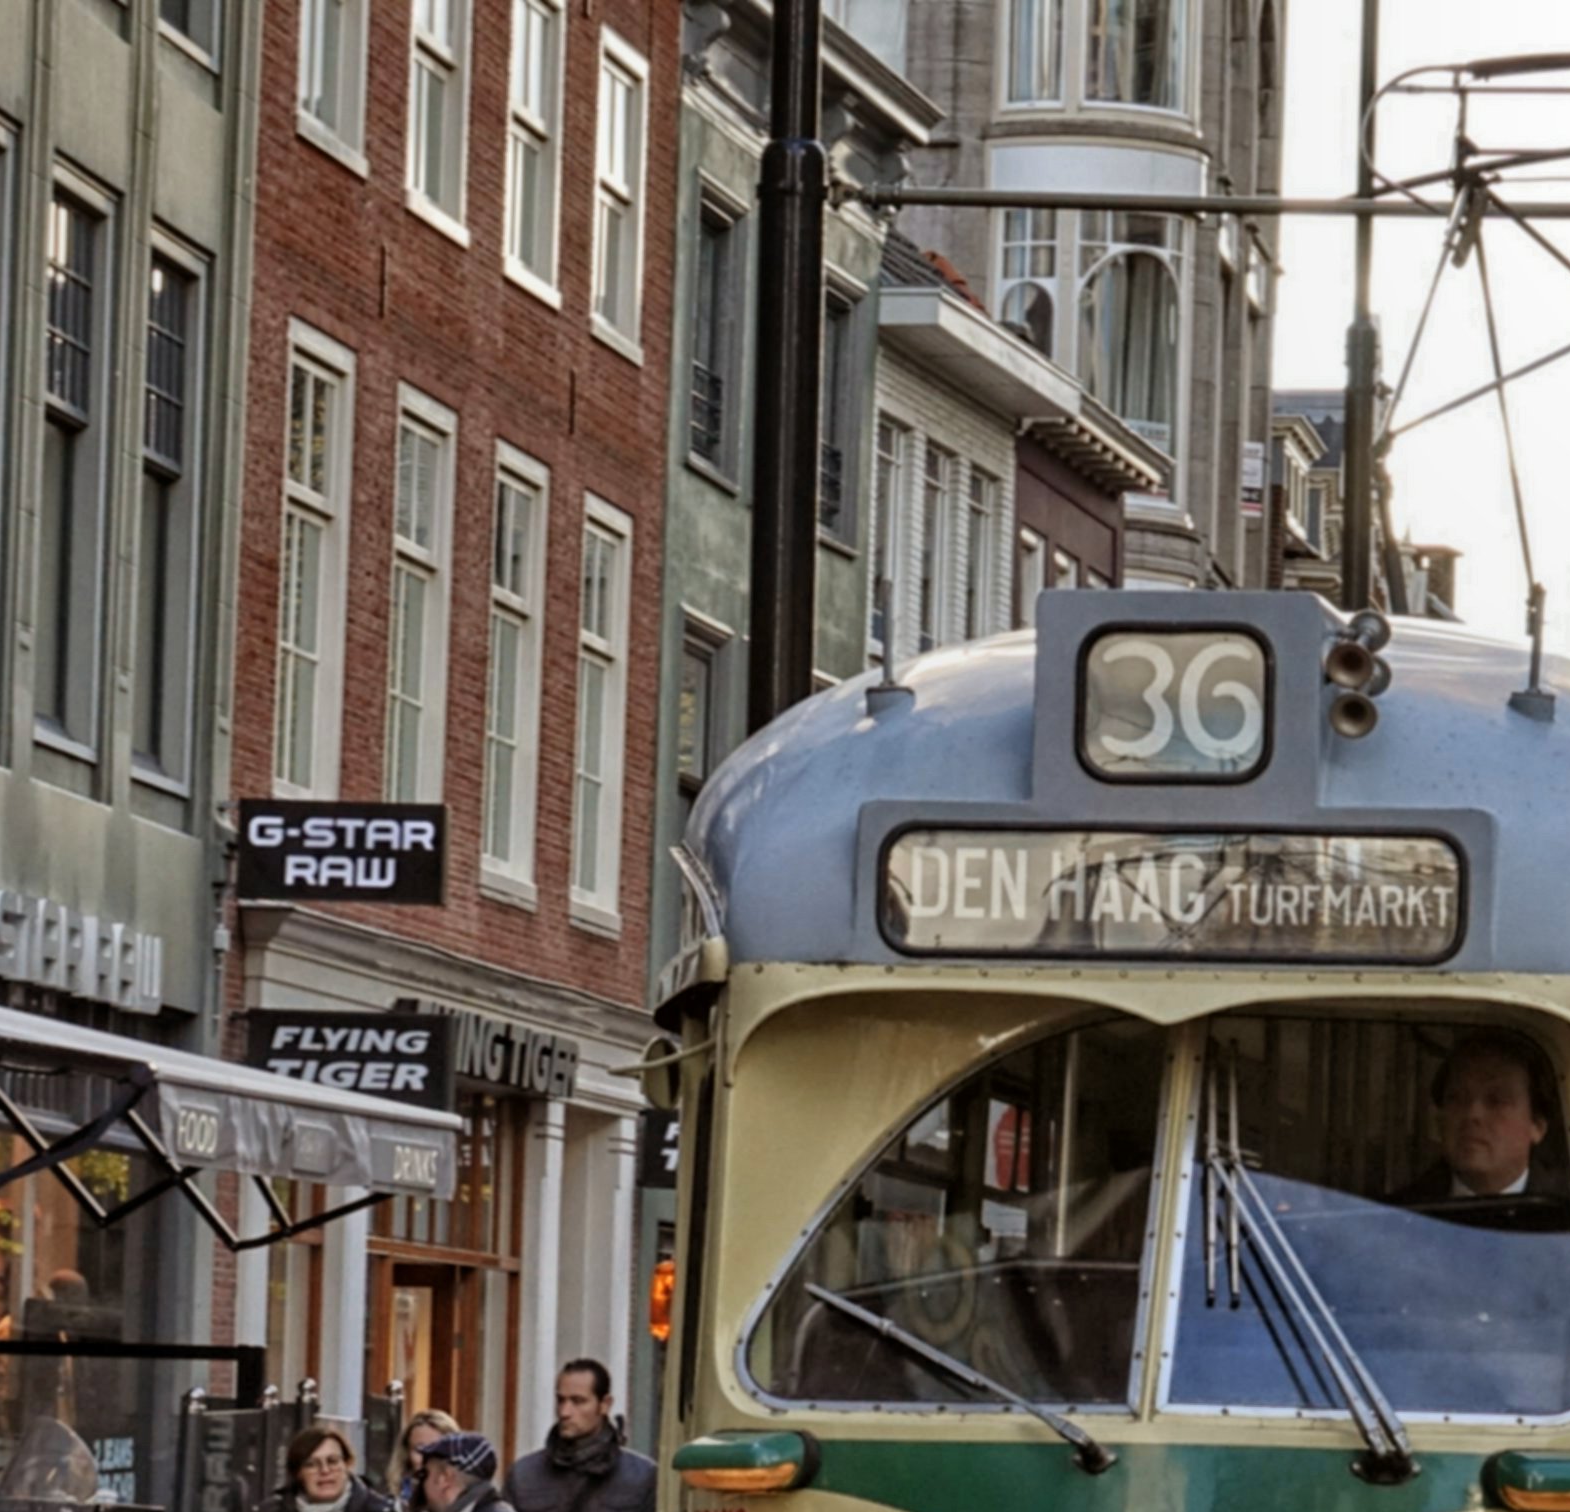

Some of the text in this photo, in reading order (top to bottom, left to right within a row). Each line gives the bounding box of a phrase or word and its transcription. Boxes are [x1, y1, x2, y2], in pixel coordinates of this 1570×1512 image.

[1101, 640, 1262, 760] 36
[247, 815, 436, 850] G-STAR
[284, 855, 397, 888] RAW
[911, 845, 1454, 930] DEN HAAG TURFMARKT
[272, 1027, 431, 1054] FLYING
[267, 1059, 428, 1090] TIGER
[178, 1109, 217, 1154] FOOD
